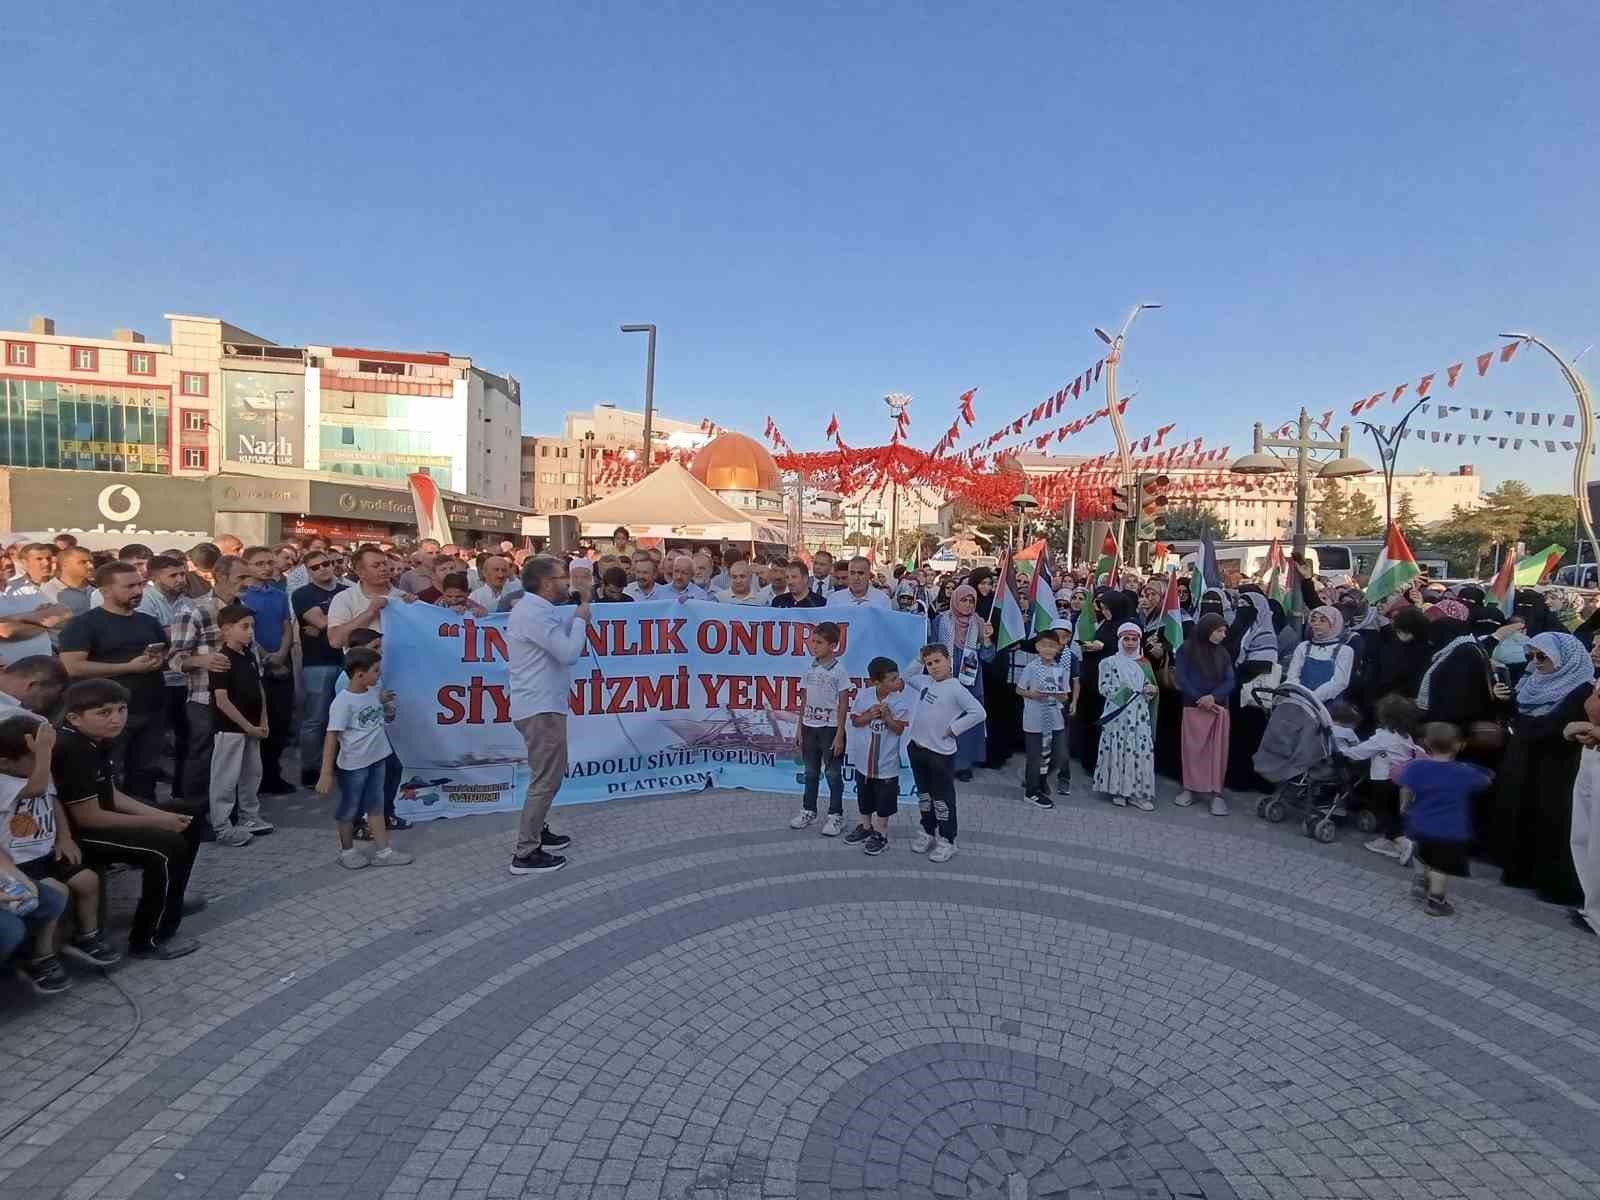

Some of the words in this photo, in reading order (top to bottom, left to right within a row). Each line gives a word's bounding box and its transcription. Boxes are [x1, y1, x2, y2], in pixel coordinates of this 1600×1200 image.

[437, 666, 690, 724] SİYNİZMİ
[647, 748, 695, 770] SİVİL
[697, 749, 776, 768] TOPLUM
